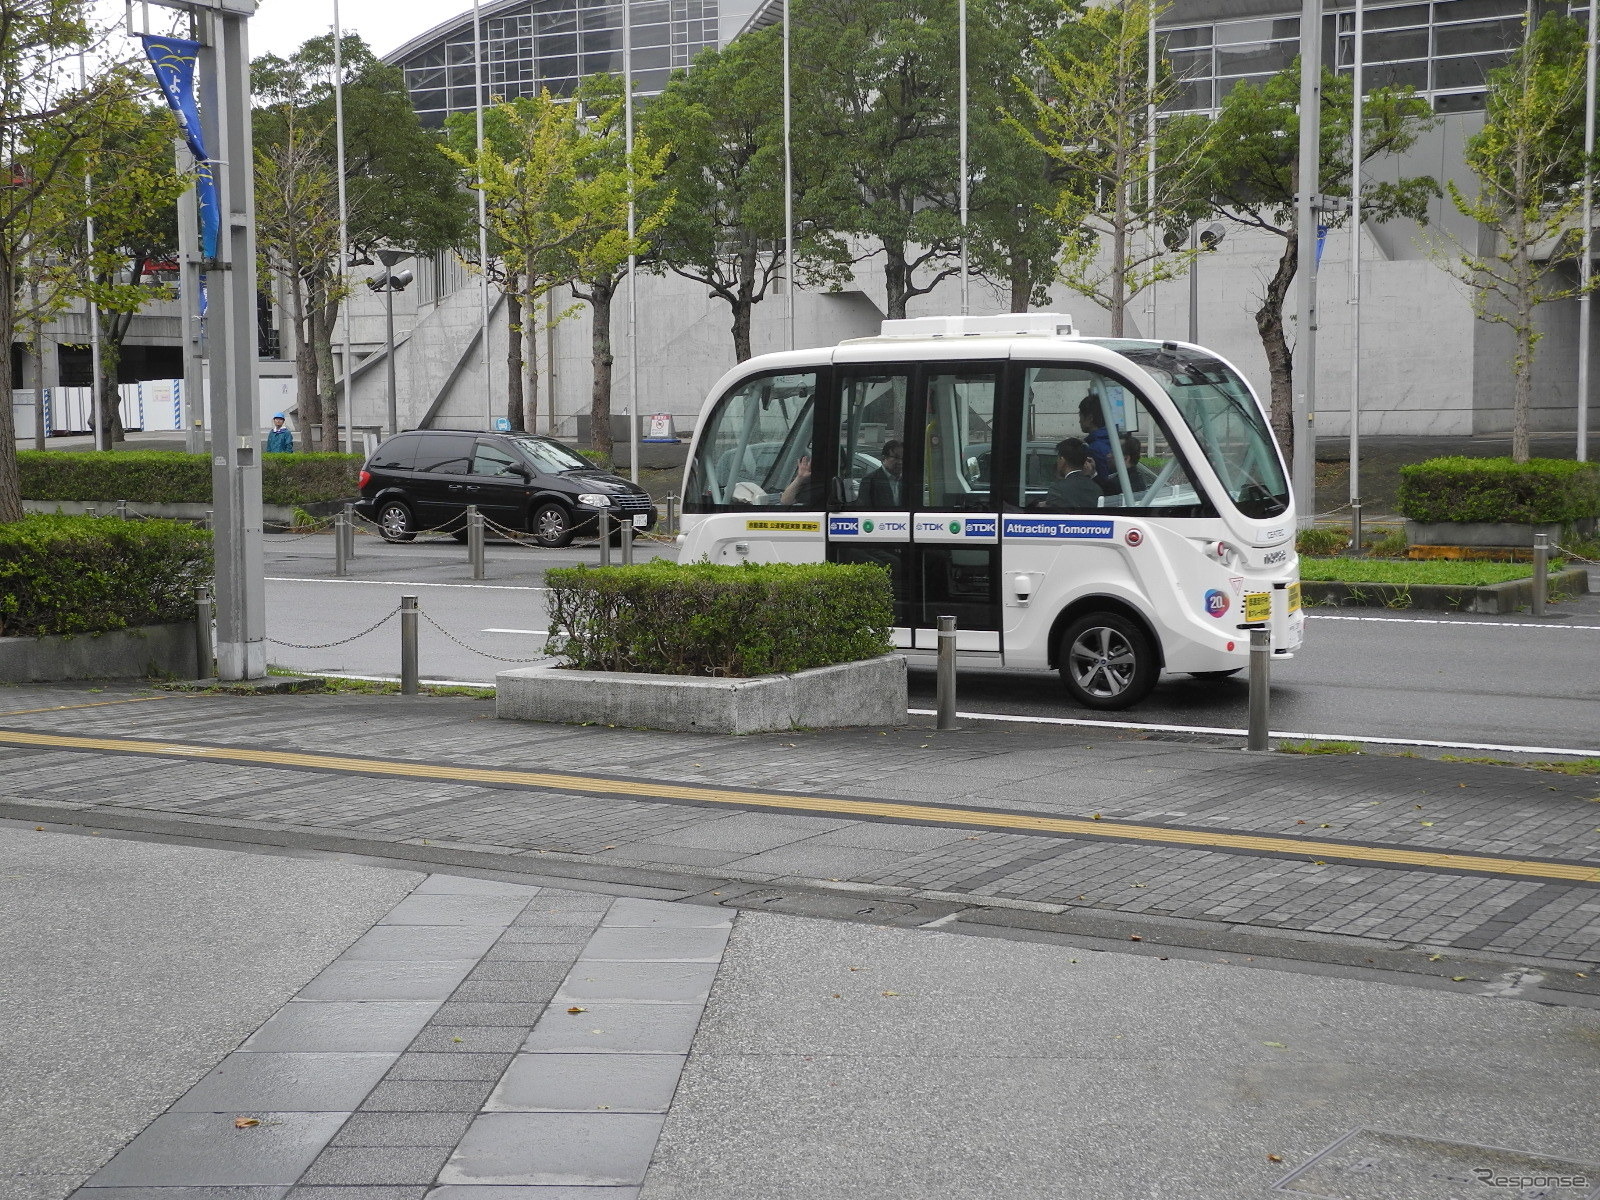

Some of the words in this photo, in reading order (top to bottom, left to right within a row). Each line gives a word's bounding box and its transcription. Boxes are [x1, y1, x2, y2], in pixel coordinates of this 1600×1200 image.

[837, 522, 858, 530] TDK
[885, 522, 907, 531] TDK
[922, 523, 944, 531] TDK
[973, 523, 995, 532] TDK
[1006, 523, 1057, 536] Attracting
[1058, 524, 1111, 535] Tomorrow
